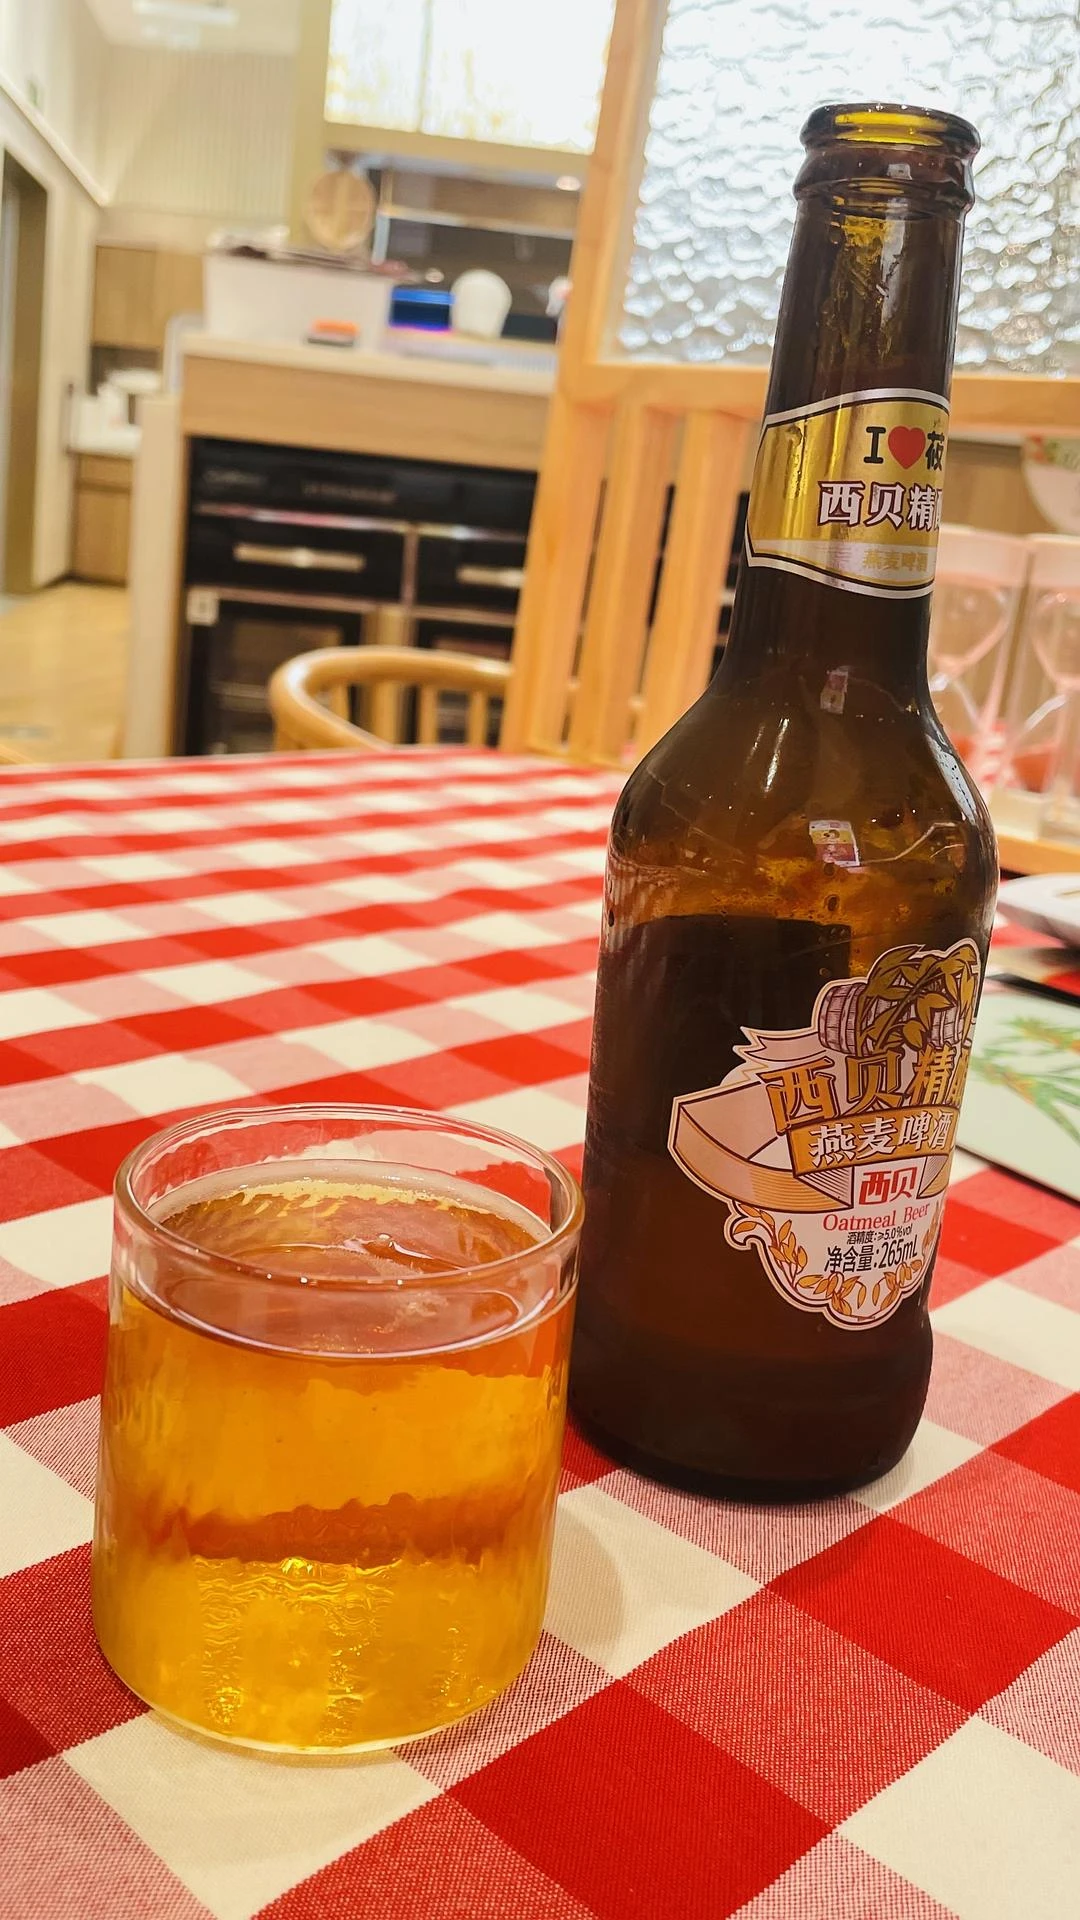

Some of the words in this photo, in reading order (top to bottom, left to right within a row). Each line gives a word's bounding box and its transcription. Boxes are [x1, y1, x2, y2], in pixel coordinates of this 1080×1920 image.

[863, 426, 886, 464] I
[808, 1110, 954, 1168] 燕麦啤酒
[859, 1166, 916, 1205] 西贝
[823, 1210, 896, 1231] Oatmeal
[903, 1203, 930, 1224] Beer
